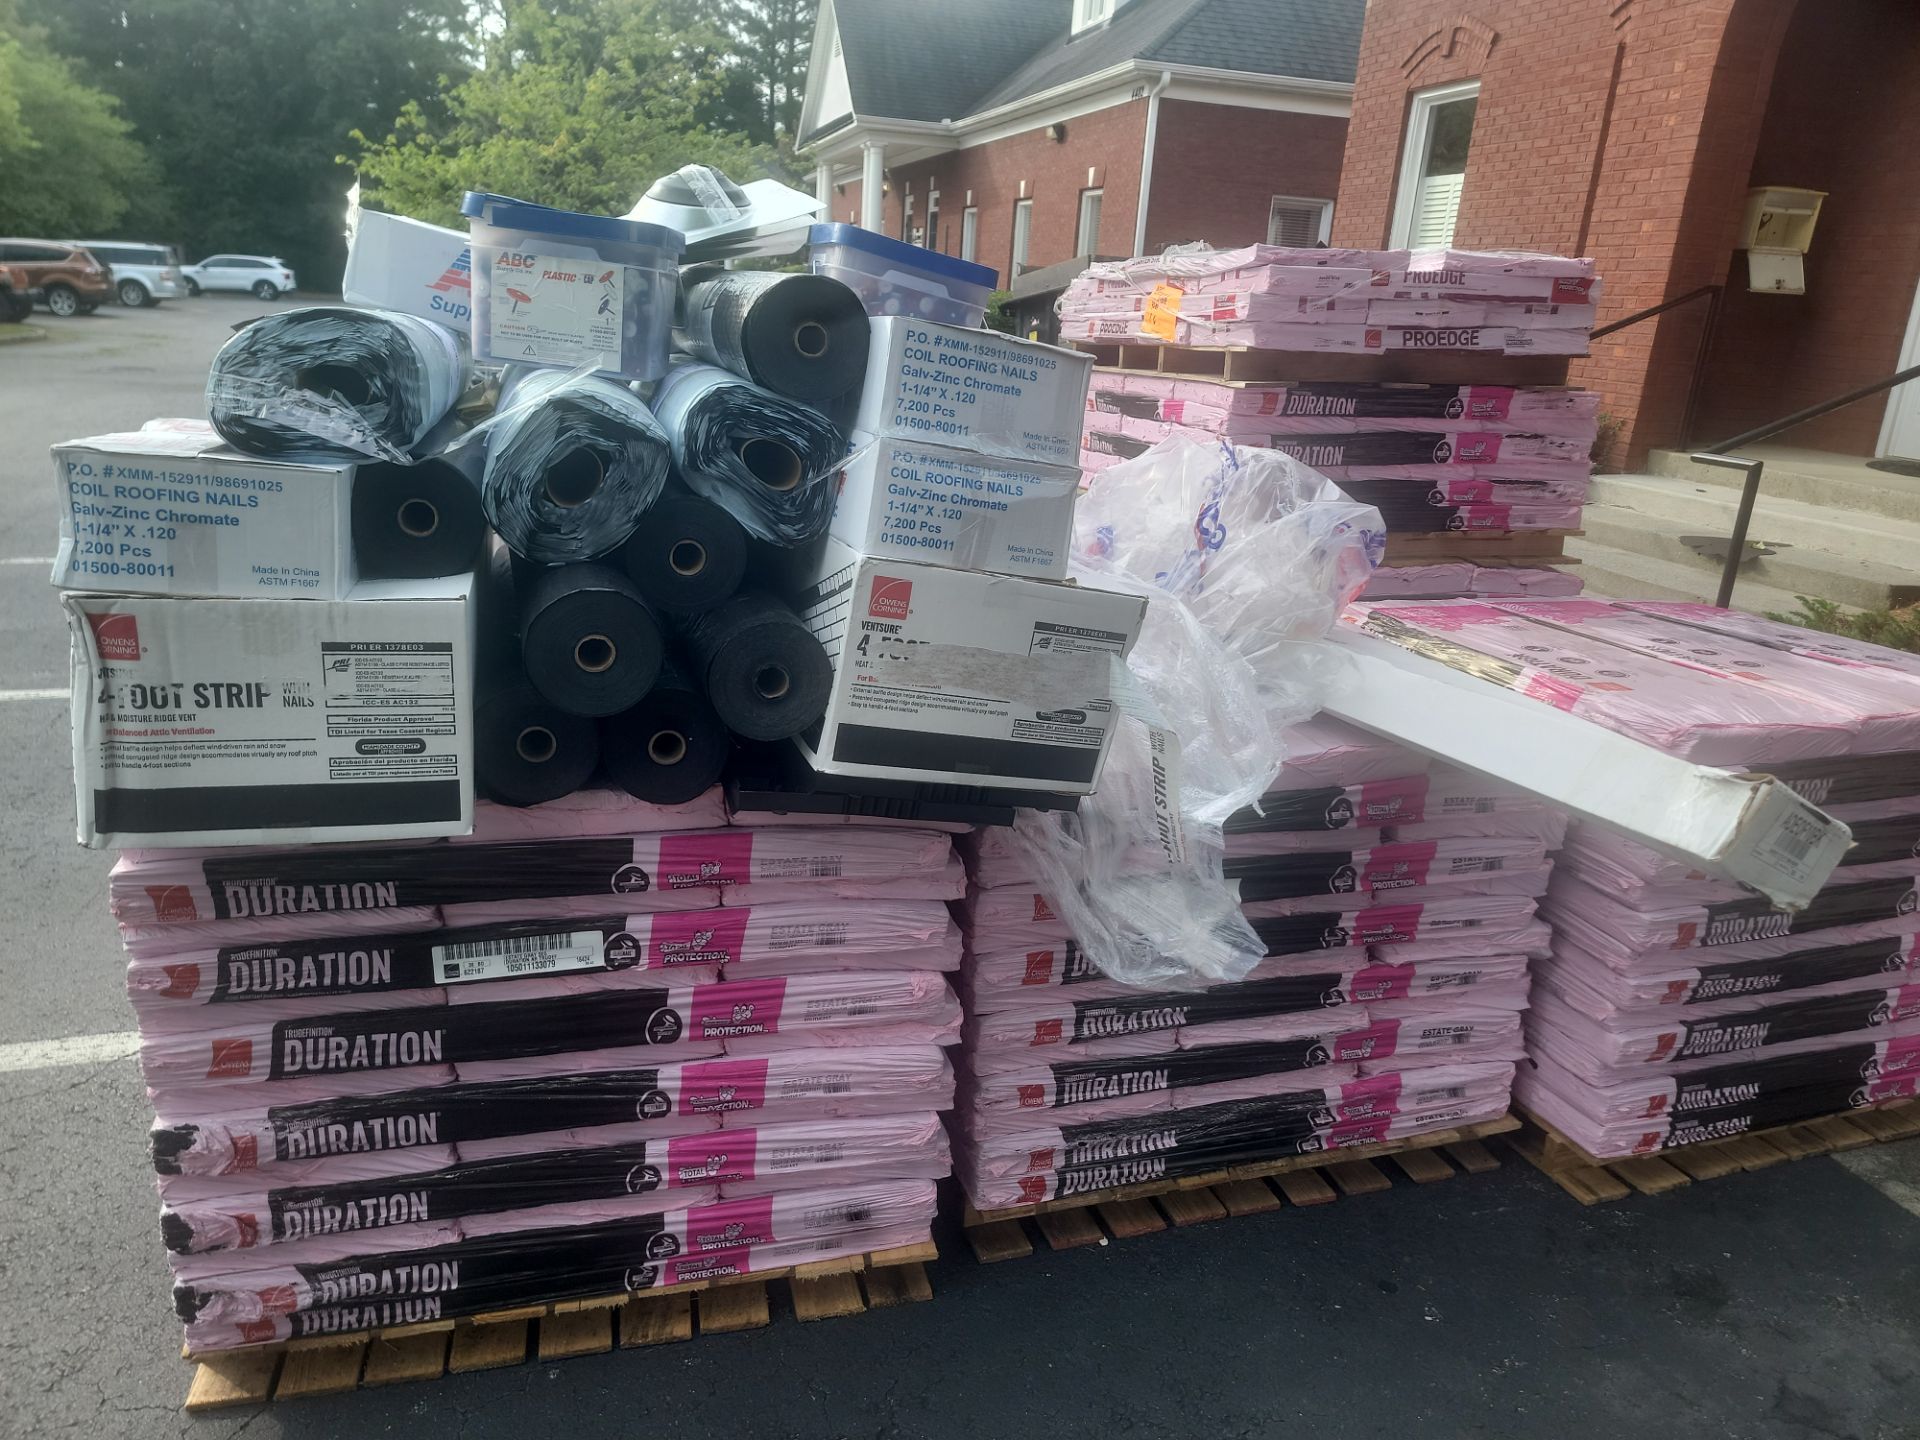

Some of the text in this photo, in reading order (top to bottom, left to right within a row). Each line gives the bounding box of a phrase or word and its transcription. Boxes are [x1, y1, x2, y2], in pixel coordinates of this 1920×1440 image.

[495, 251, 537, 268] ABC
[542, 270, 576, 283] PLASTIC
[430, 295, 471, 322] Sup
[906, 330, 931, 346] P.O.
[1402, 330, 1480, 347] PROEDGE
[904, 347, 1038, 382] COIL ROOFING NAILS
[901, 365, 1022, 397] Galv-Zinc Chromate
[939, 388, 948, 400] X
[951, 392, 976, 405] .120
[897, 398, 956, 418] 7,200 Pcs
[1287, 395, 1356, 415] DURATION
[895, 415, 970, 437] 01500-80011
[1023, 431, 1042, 442] Made
[1025, 441, 1048, 452] ASTM
[67, 462, 98, 478] P.O.
[890, 467, 1024, 497] COIL ROOFING NAILS
[70, 482, 259, 508] COIL ROOFING NAILS
[888, 483, 1009, 512] Galv-Zinc Chromate
[71, 501, 240, 527] Galv-Zinc Chromate
[925, 505, 934, 517] X
[937, 508, 963, 521] .120
[124, 525, 135, 538] X
[142, 527, 176, 541] .120
[884, 515, 942, 535] 7,200 Pcs
[881, 532, 955, 552] 01500-80011
[120, 543, 152, 558] Pcs
[1007, 544, 1026, 554] Made
[1035, 547, 1054, 558] China
[1009, 554, 1031, 564] ASTM
[72, 560, 175, 578] 01500-80011
[252, 565, 320, 577] Made In China
[258, 577, 320, 588] ASTM F1667
[872, 603, 906, 615] CORNING
[879, 598, 907, 608] OWENS
[101, 636, 136, 646] OWENS
[102, 645, 137, 655] ORNING
[283, 695, 314, 708] NAILS
[117, 714, 152, 723] MOISTURE
[154, 714, 176, 722] RIDGE
[178, 713, 197, 722] VENT
[149, 728, 170, 736] Attic
[171, 727, 215, 735] Ventilation
[141, 745, 164, 753] design
[164, 744, 183, 752] helps
[183, 743, 206, 751] deflect
[161, 753, 178, 761] ridge
[179, 752, 200, 760] design
[302, 750, 318, 758] pitch
[1152, 756, 1167, 810] STRIP
[1372, 879, 1416, 890] PROTECTION
[225, 881, 398, 919] DURATION
[1706, 913, 1793, 946] DURATION
[663, 950, 730, 964] PROTECTION
[228, 948, 392, 995] DURATION
[1083, 1007, 1188, 1036] DURATION
[285, 1027, 335, 1038] TRUDEFINITION
[703, 1023, 765, 1038] PROTECTION
[1422, 1028, 1451, 1037] ESTATE
[283, 1029, 443, 1072] DURATION
[825, 1073, 852, 1084] GRAY
[1063, 1069, 1169, 1104] DURATION
[1677, 1082, 1760, 1111] DURATION
[286, 1111, 438, 1160] DURATION
[683, 1167, 704, 1177] TOTAL
[1063, 1158, 1167, 1195] DURATION
[282, 1191, 429, 1241] DURATION
[701, 1236, 761, 1251] PROTECTION
[678, 1265, 736, 1281] PROTECTION
[320, 1260, 460, 1305] DURATION
